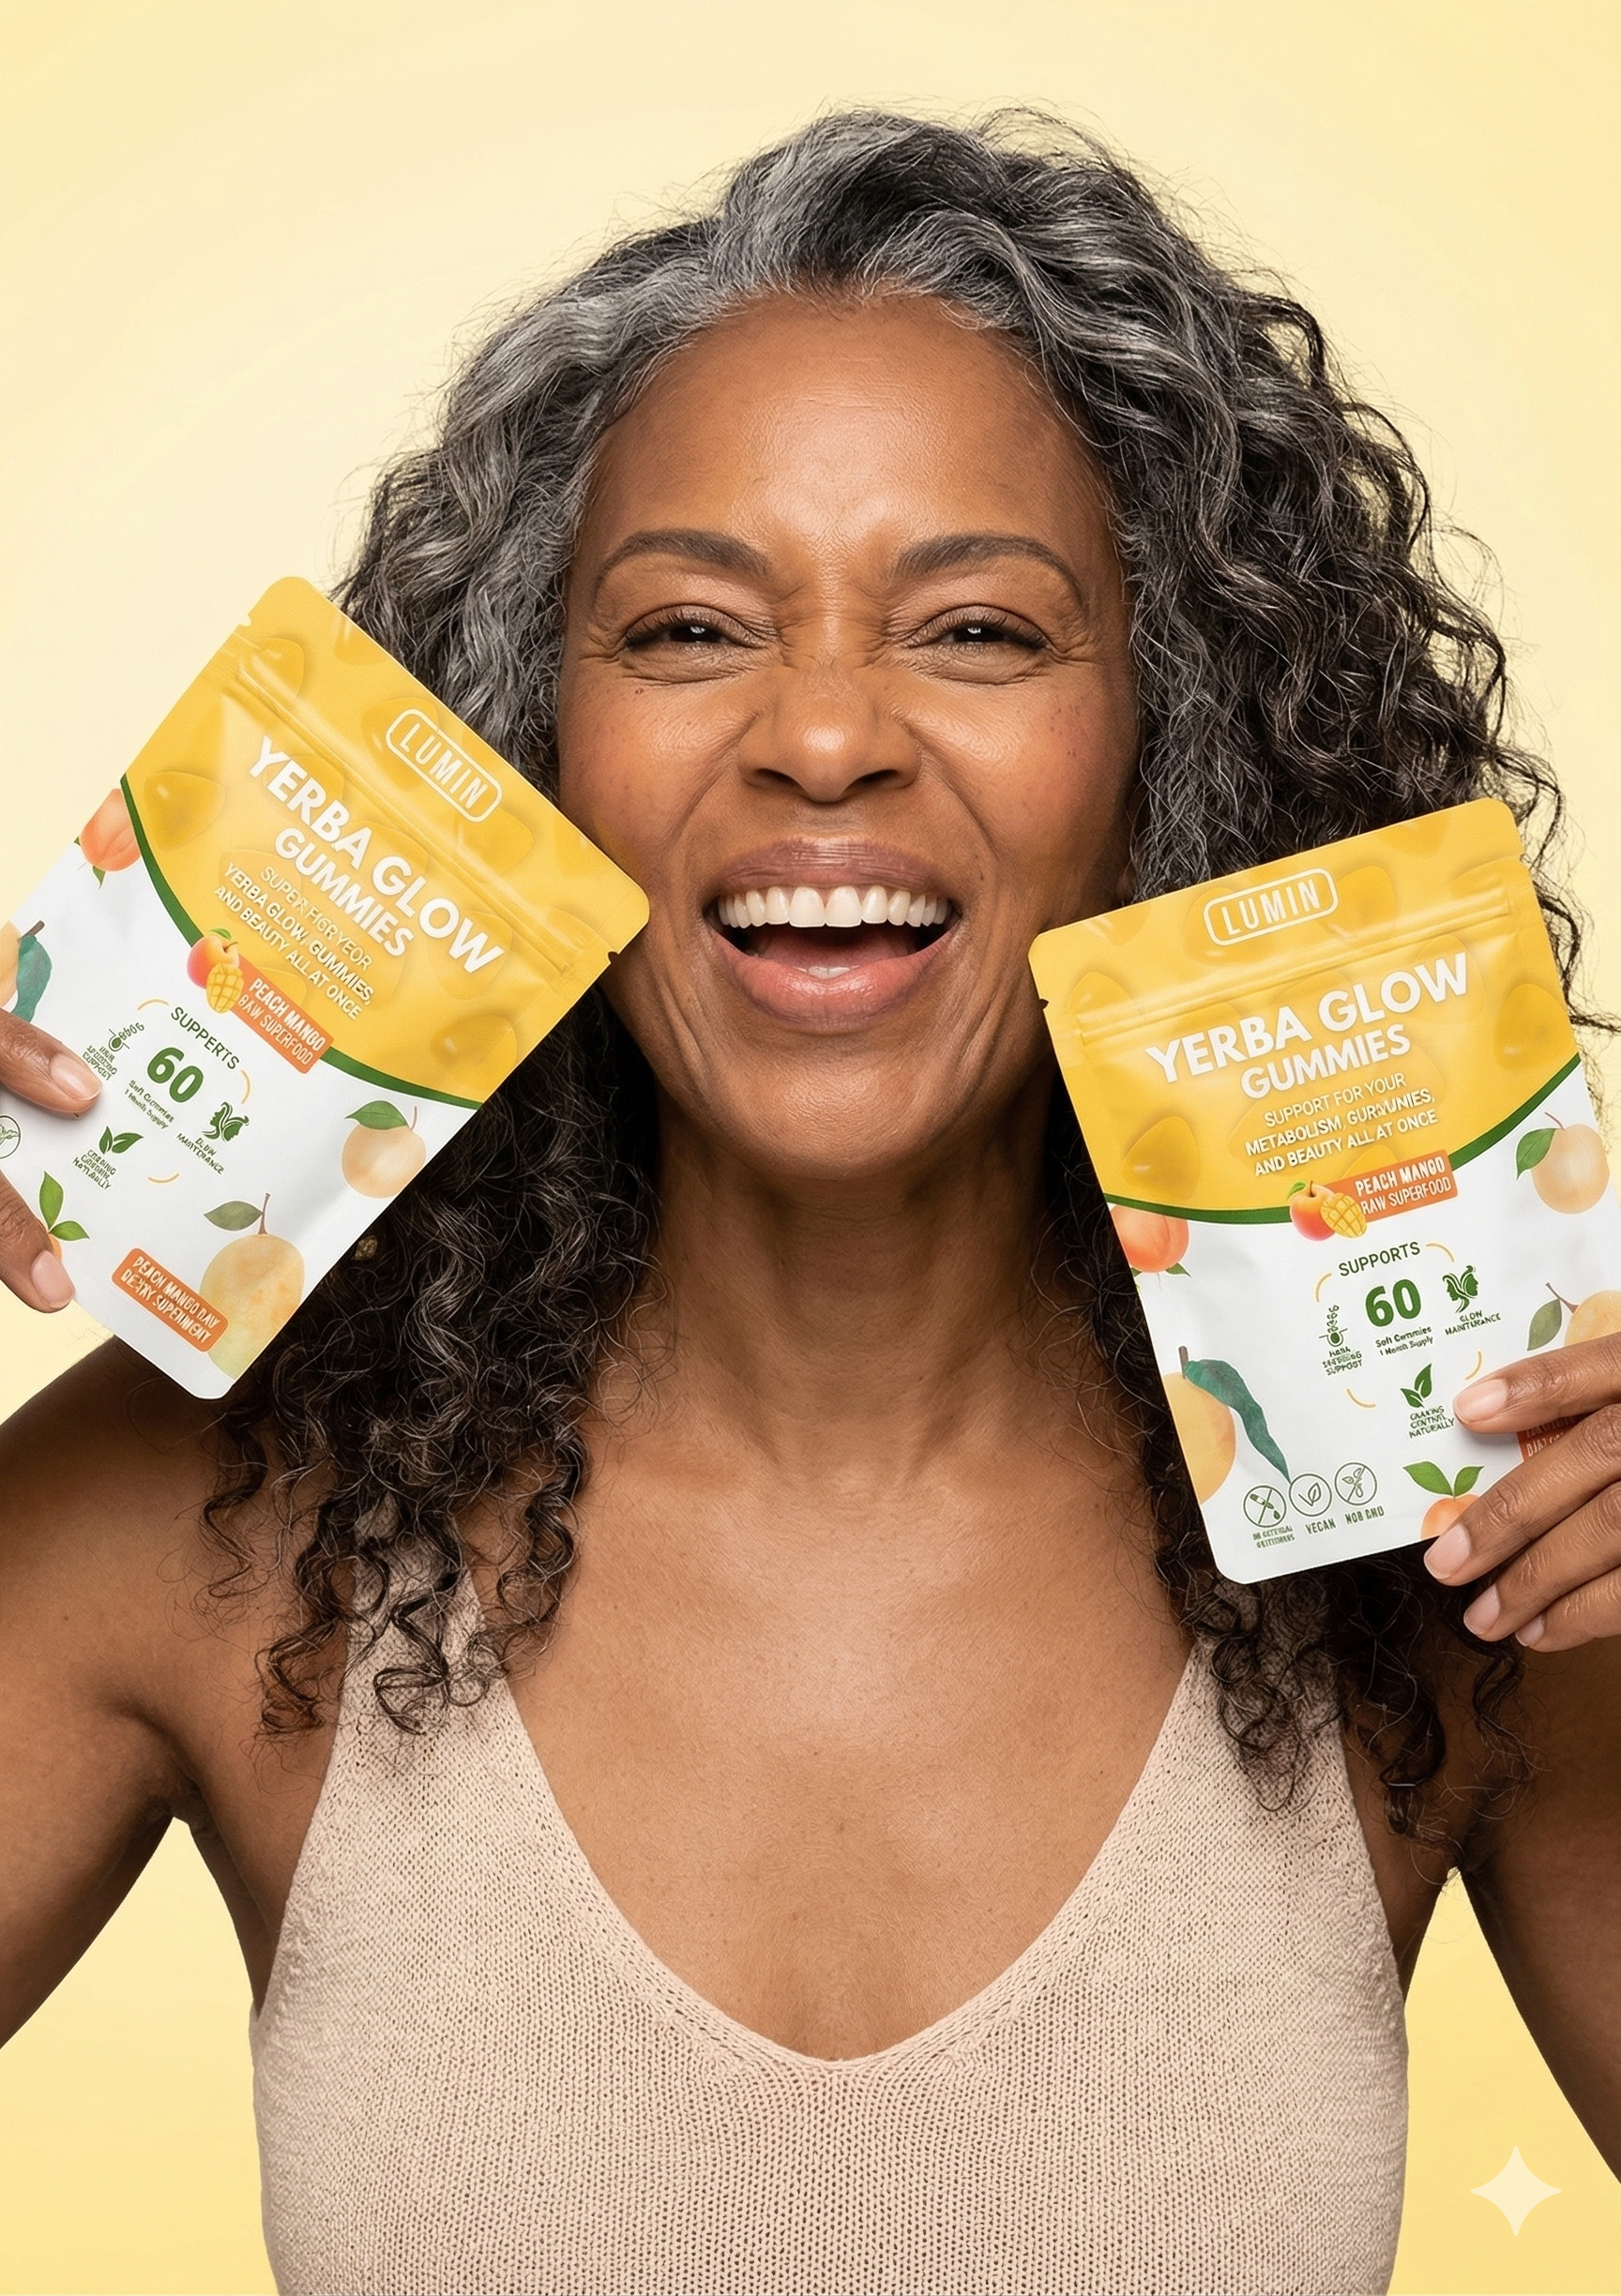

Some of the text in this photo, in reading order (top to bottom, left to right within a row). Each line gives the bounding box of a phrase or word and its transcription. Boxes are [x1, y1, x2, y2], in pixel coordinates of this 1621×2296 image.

[399, 722, 489, 809] LUMIN
[249, 734, 505, 974] YERBA GLOW
[275, 827, 415, 957] GUMMIES
[1220, 879, 1321, 936] LUMIN
[213, 885, 363, 1020] AND BEAUTY ALL AT ONCE
[224, 862, 269, 909] YERBA
[308, 936, 374, 1004] GUMMIES,
[249, 977, 290, 1018] PEACH
[1144, 952, 1467, 1083] YERBA GLOW
[146, 1047, 205, 1104] 60
[1241, 1023, 1411, 1099] GUMMIES
[1264, 1072, 1407, 1127] SUPPORT FOR YOUR
[1245, 1114, 1346, 1156] METABOLISM,
[1255, 1108, 1438, 1177] AND BEAUTY ALL AT ONCE
[1355, 1170, 1399, 1197] PEACH
[1360, 1176, 1452, 1215] RAW SUPERFOOD
[1338, 1241, 1421, 1276] SUPPORTS
[1365, 1278, 1422, 1327] 60
